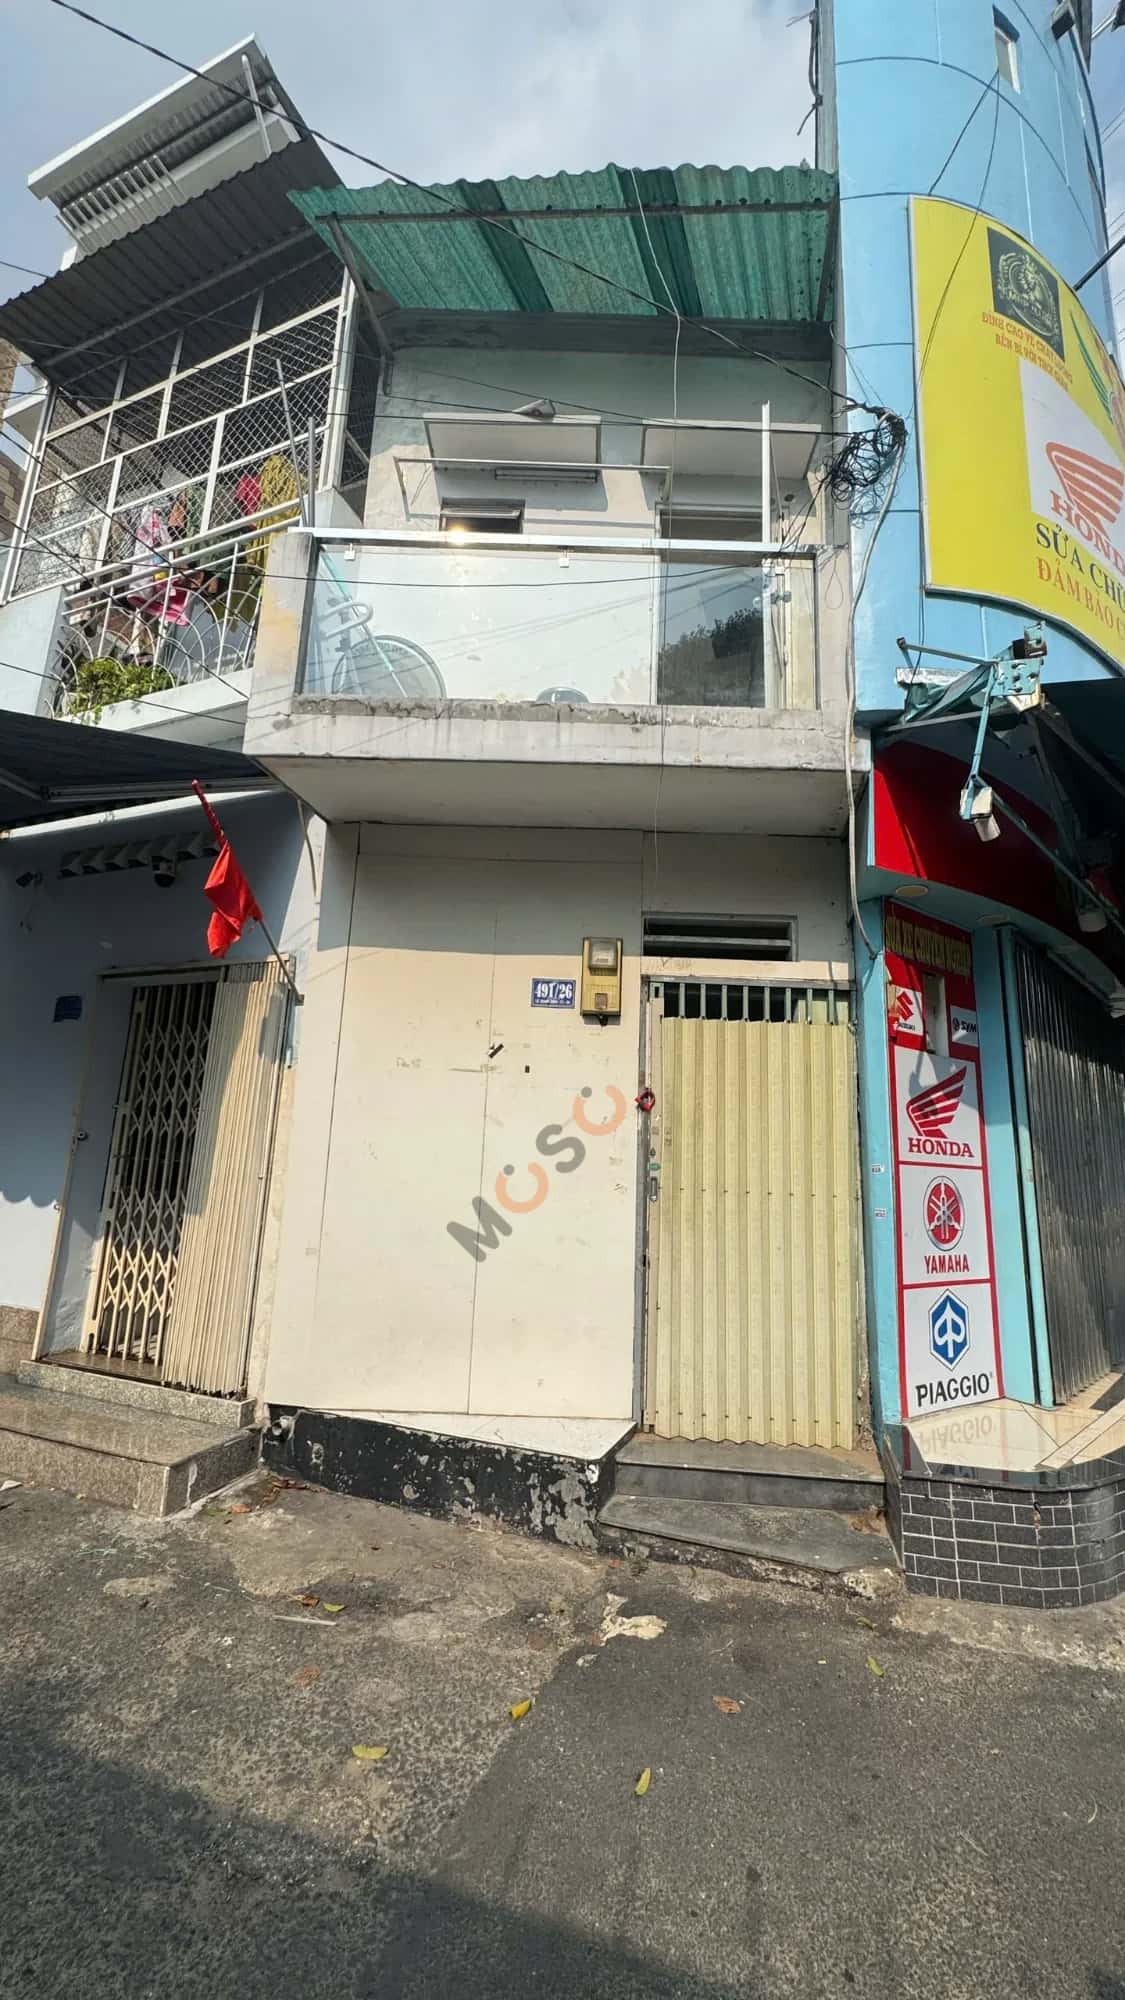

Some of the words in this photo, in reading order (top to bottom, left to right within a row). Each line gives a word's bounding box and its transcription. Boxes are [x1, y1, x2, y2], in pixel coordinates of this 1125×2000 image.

[1036, 522, 1084, 575] SỬA
[908, 1137, 975, 1158] HONDA
[924, 1254, 970, 1274] YAMAHA
[915, 1373, 990, 1407] PIAGGIO
